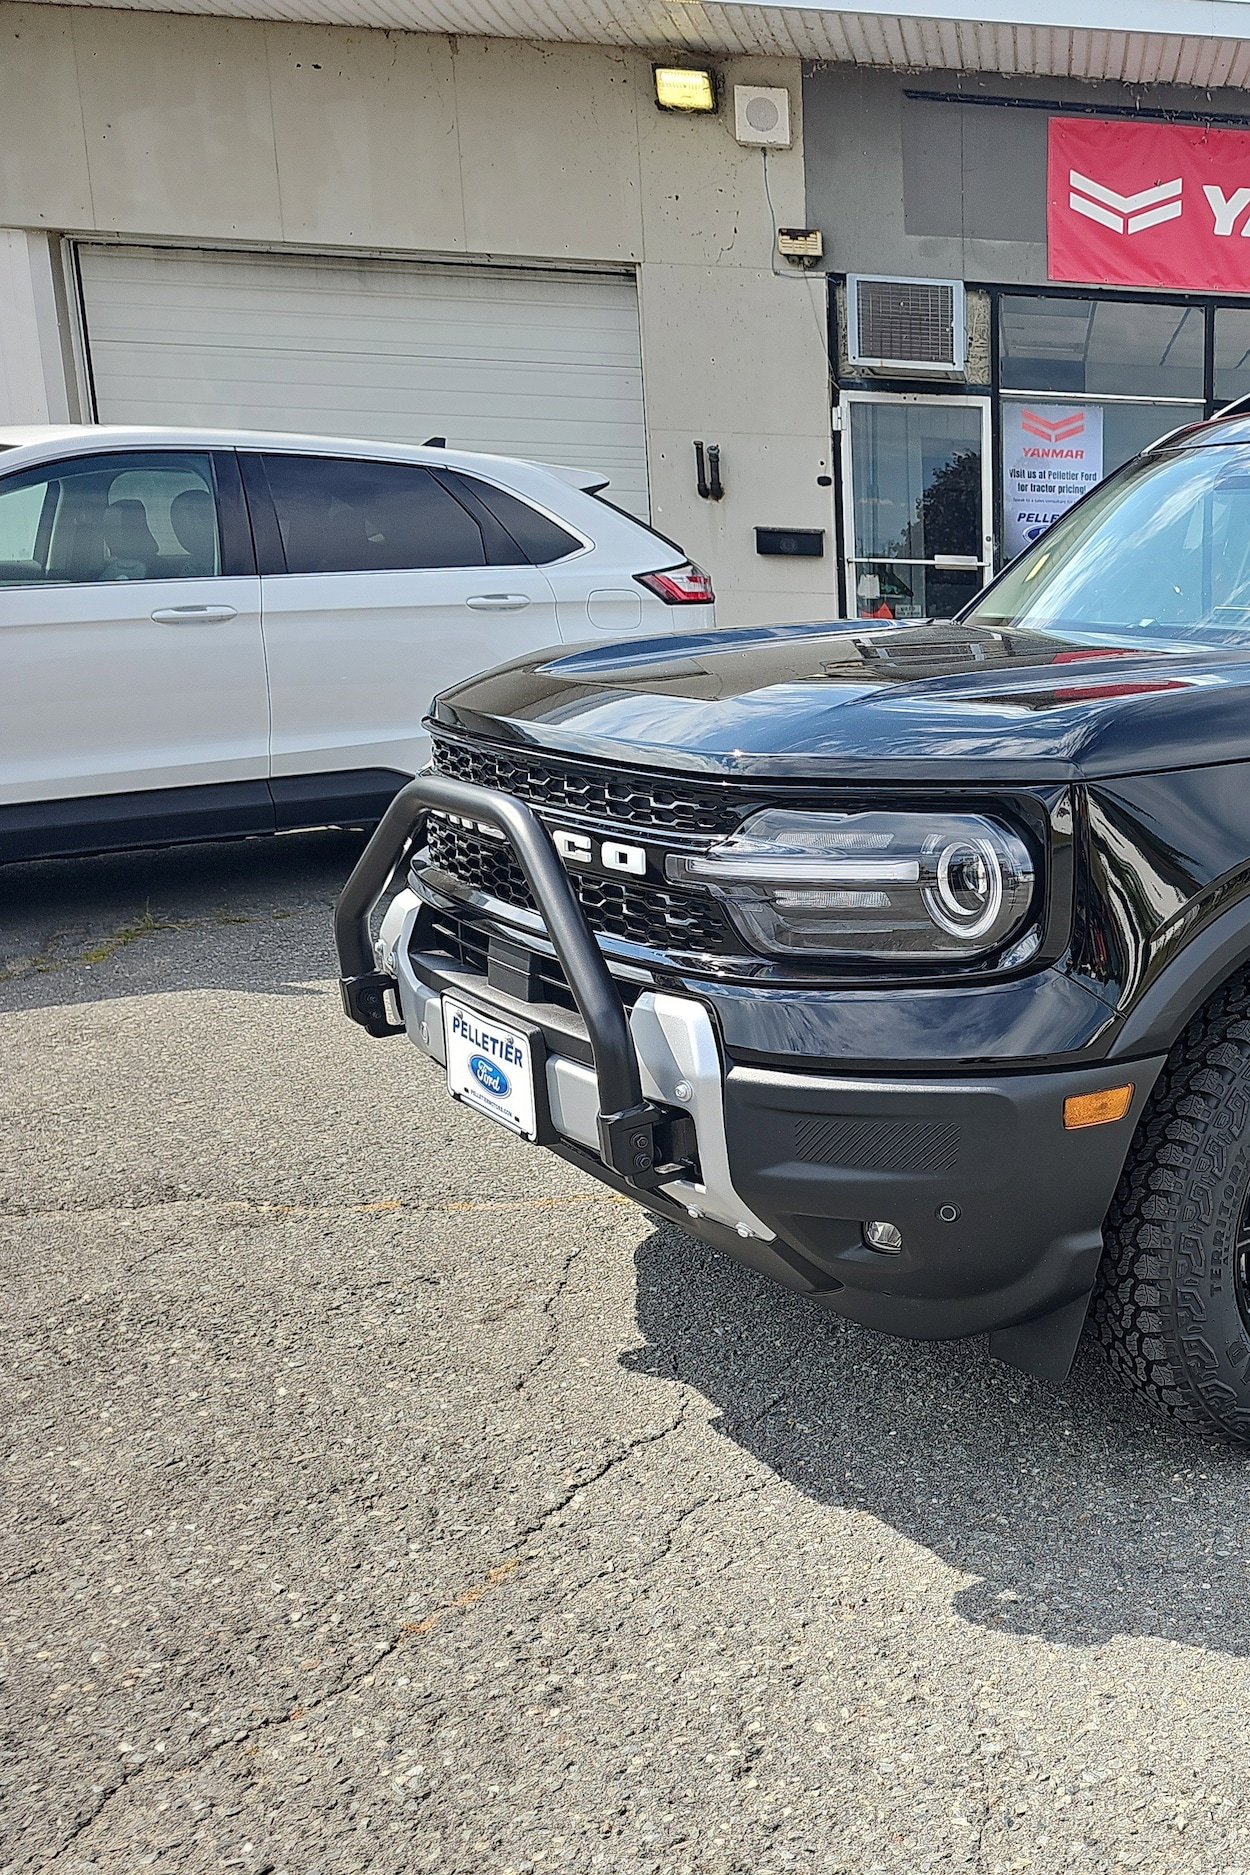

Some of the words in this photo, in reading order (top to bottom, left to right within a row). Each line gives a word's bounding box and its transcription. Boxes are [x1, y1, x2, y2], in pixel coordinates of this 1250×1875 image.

[1022, 447, 1084, 459] YANMAR
[1009, 469, 1026, 479] Visit
[1027, 470, 1036, 479] us
[1038, 470, 1046, 479] at
[1048, 470, 1079, 480] Pelletier
[1081, 472, 1097, 481] Ford
[1017, 483, 1028, 492] for
[1030, 483, 1056, 493] tractor
[1017, 513, 1060, 523] PELLE
[453, 1016, 524, 1068] PELLETIER
[476, 1060, 501, 1092] Ford
[1210, 1147, 1248, 1297] TERRITORY
